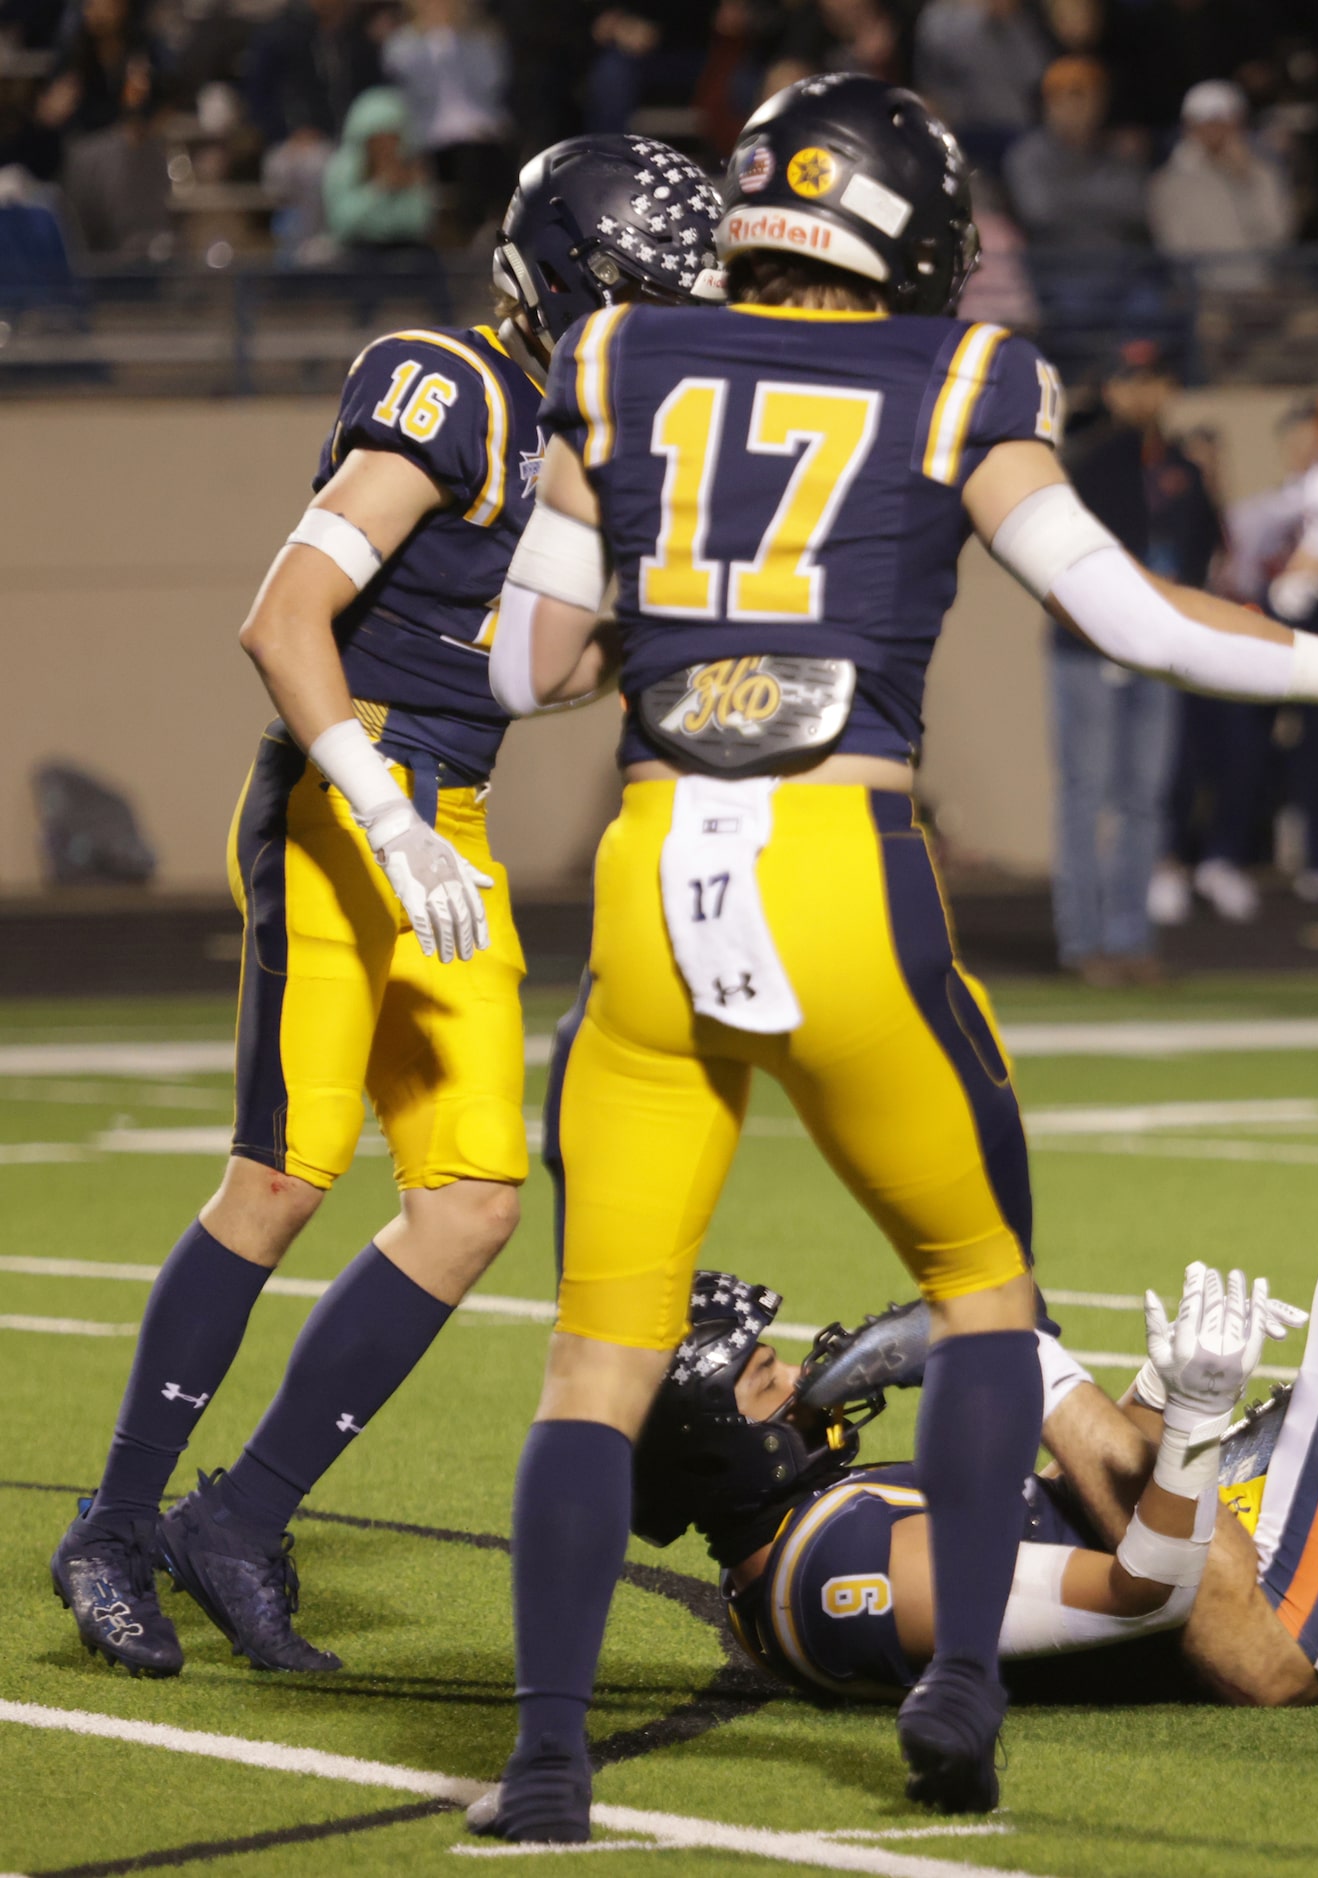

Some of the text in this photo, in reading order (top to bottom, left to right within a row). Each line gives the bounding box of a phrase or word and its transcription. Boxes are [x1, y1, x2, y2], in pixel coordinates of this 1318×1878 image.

[728, 215, 832, 251] Riddell
[372, 359, 458, 443] 16
[638, 376, 883, 623] 17
[688, 871, 730, 922] 17
[821, 1572, 892, 1619] 6
